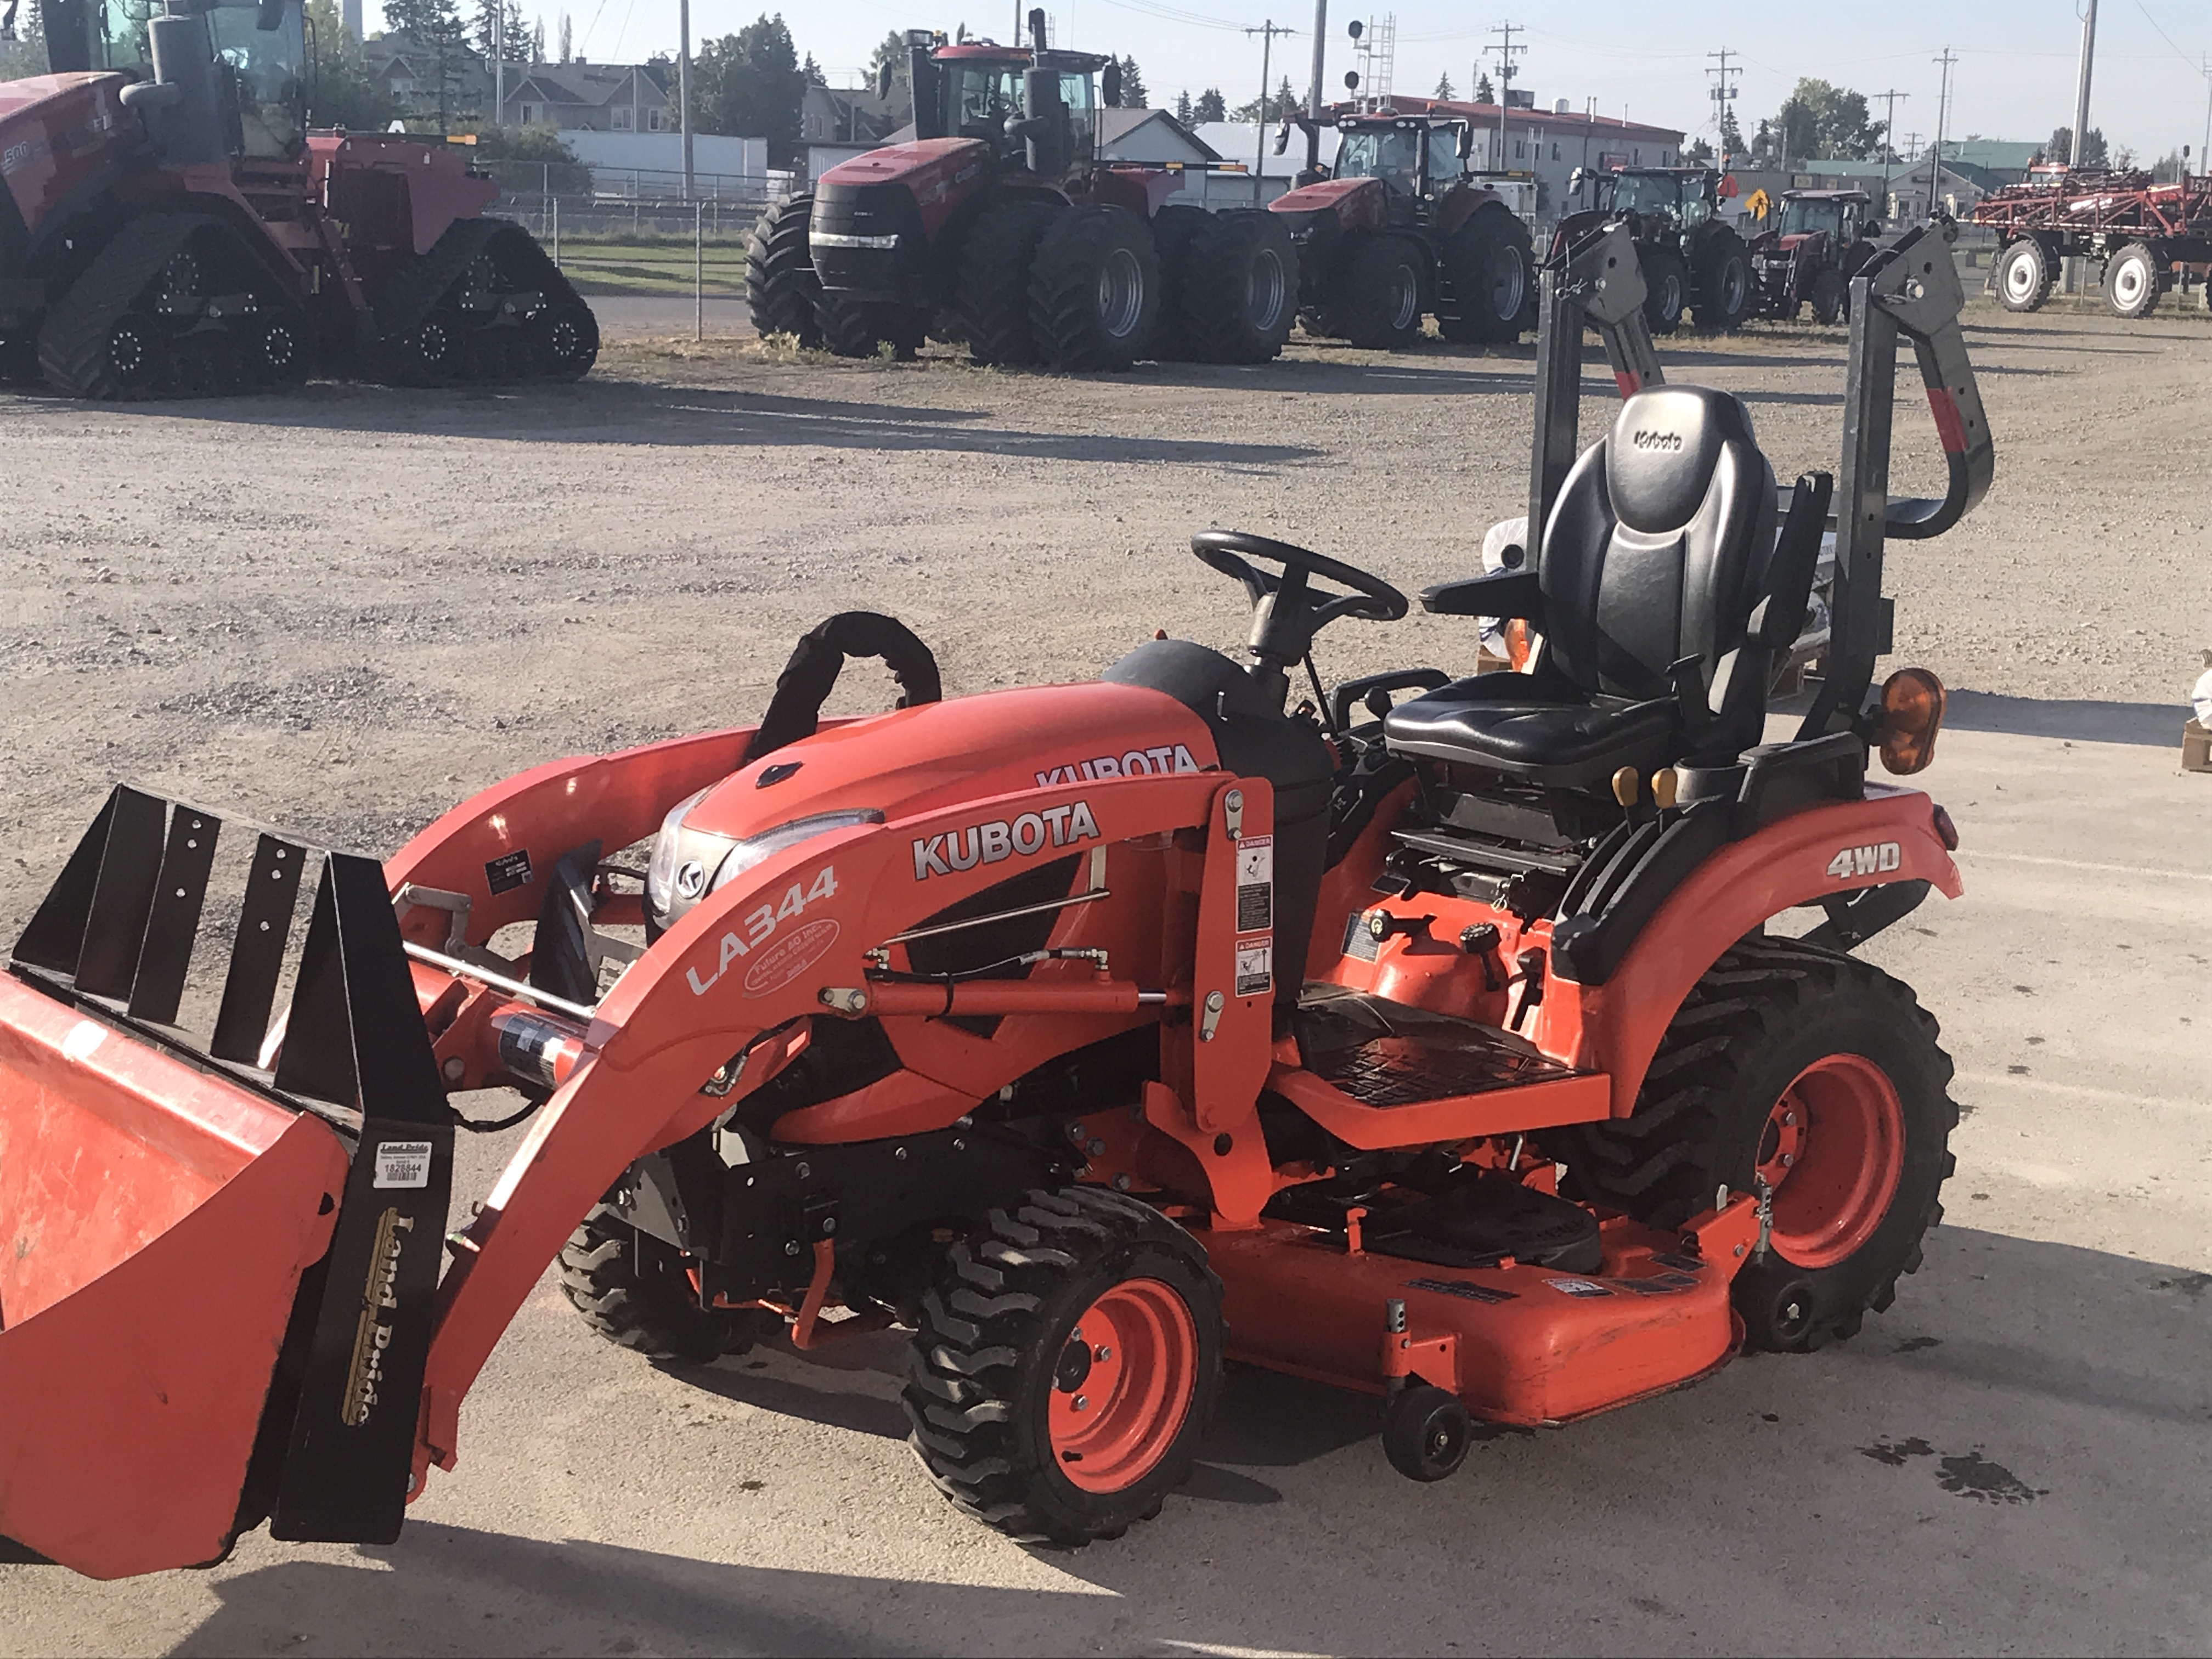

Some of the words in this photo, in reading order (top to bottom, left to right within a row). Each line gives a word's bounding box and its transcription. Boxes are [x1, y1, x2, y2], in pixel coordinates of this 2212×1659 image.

[1633, 431, 1682, 451] Kubota
[912, 800, 1101, 881] KUBOTA
[1826, 841, 1900, 879] 4WD
[686, 865, 838, 996] LA344
[374, 1206, 415, 1310] Land
[351, 1319, 393, 1427] Pride
